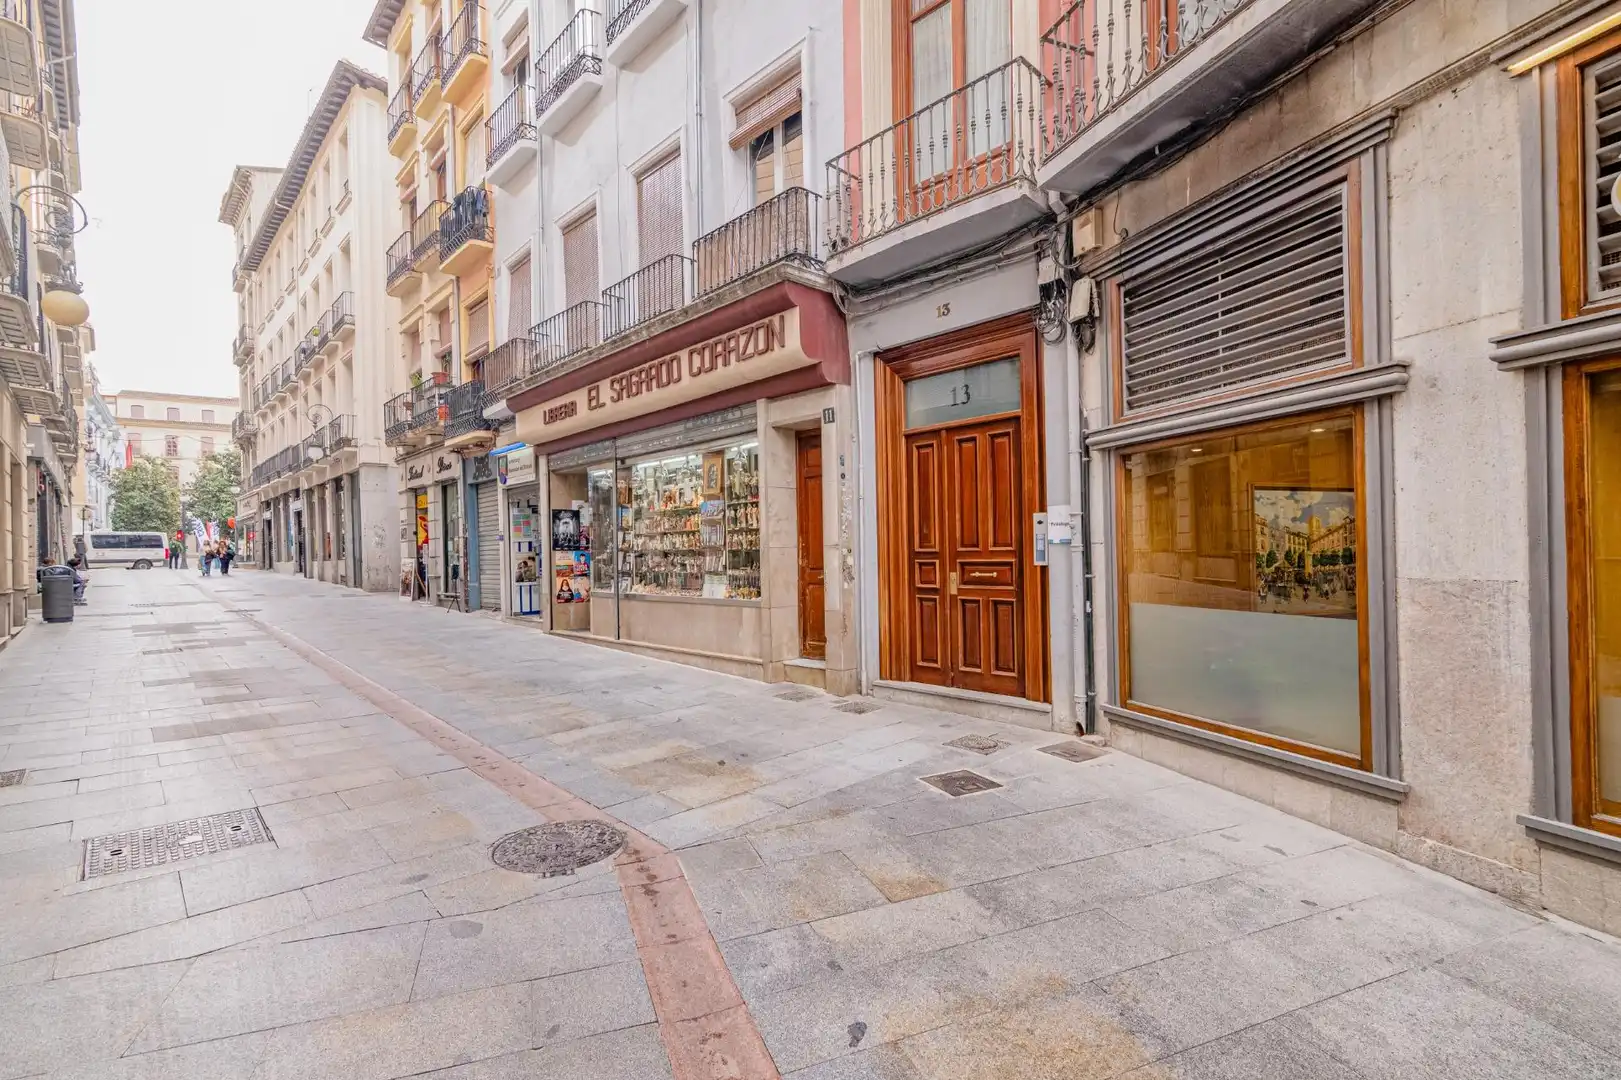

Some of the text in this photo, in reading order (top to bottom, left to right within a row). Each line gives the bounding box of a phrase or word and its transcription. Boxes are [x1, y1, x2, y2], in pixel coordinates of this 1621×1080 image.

[936, 302, 951, 319] 13
[543, 314, 786, 425] LIBRERIA EL SAGRADO CORAZON
[948, 383, 971, 407] 13
[824, 409, 833, 422] 11
